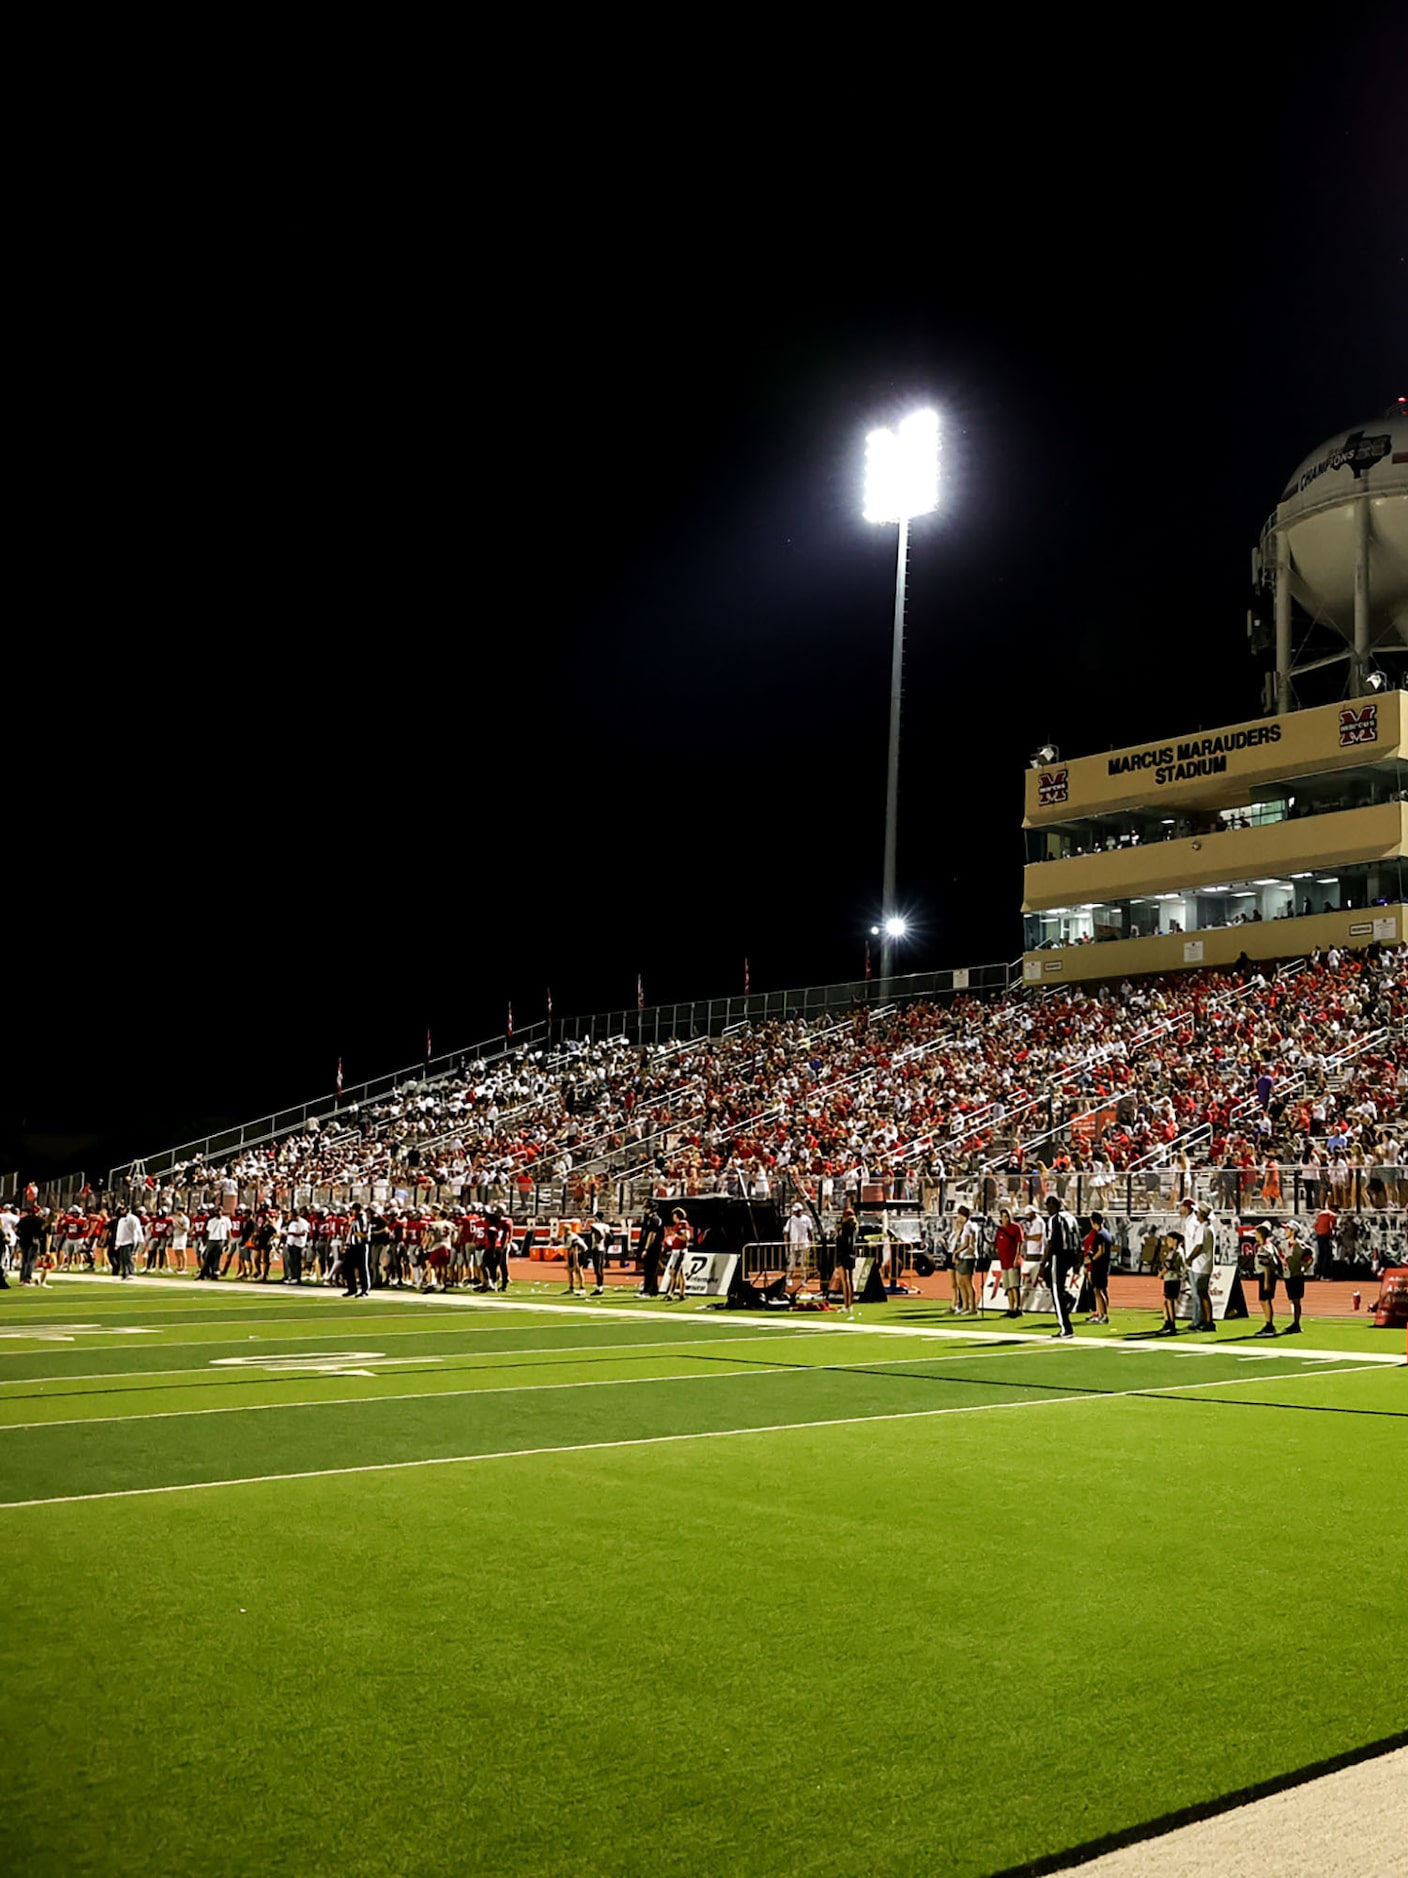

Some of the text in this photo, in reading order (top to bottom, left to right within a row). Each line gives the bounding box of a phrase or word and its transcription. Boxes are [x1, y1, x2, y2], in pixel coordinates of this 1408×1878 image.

[1107, 724, 1282, 776] MARCUS MARAUDERS
[1155, 755, 1227, 784] STADIUM
